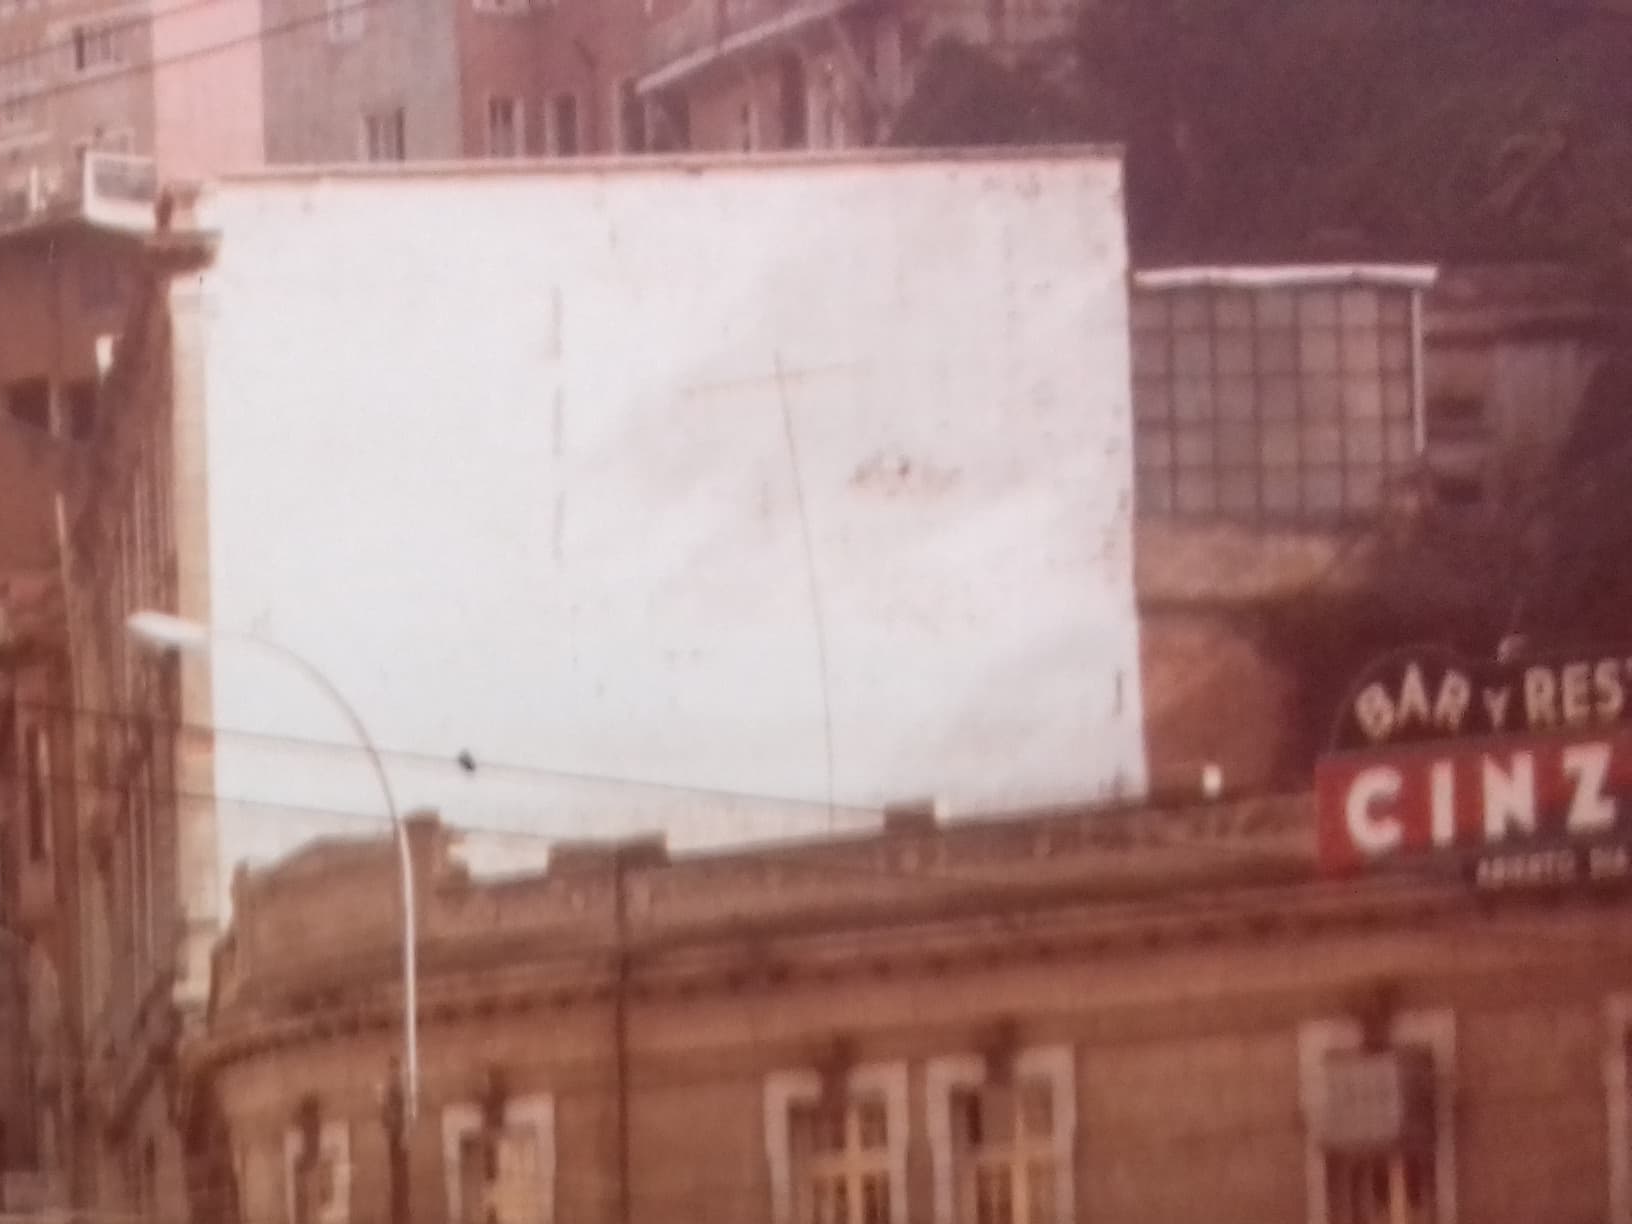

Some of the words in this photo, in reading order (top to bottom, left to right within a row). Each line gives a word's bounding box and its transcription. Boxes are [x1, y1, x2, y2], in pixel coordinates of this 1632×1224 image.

[1355, 661, 1471, 739] BAR
[1523, 657, 1632, 731] RES
[1346, 743, 1616, 851] CINZ
